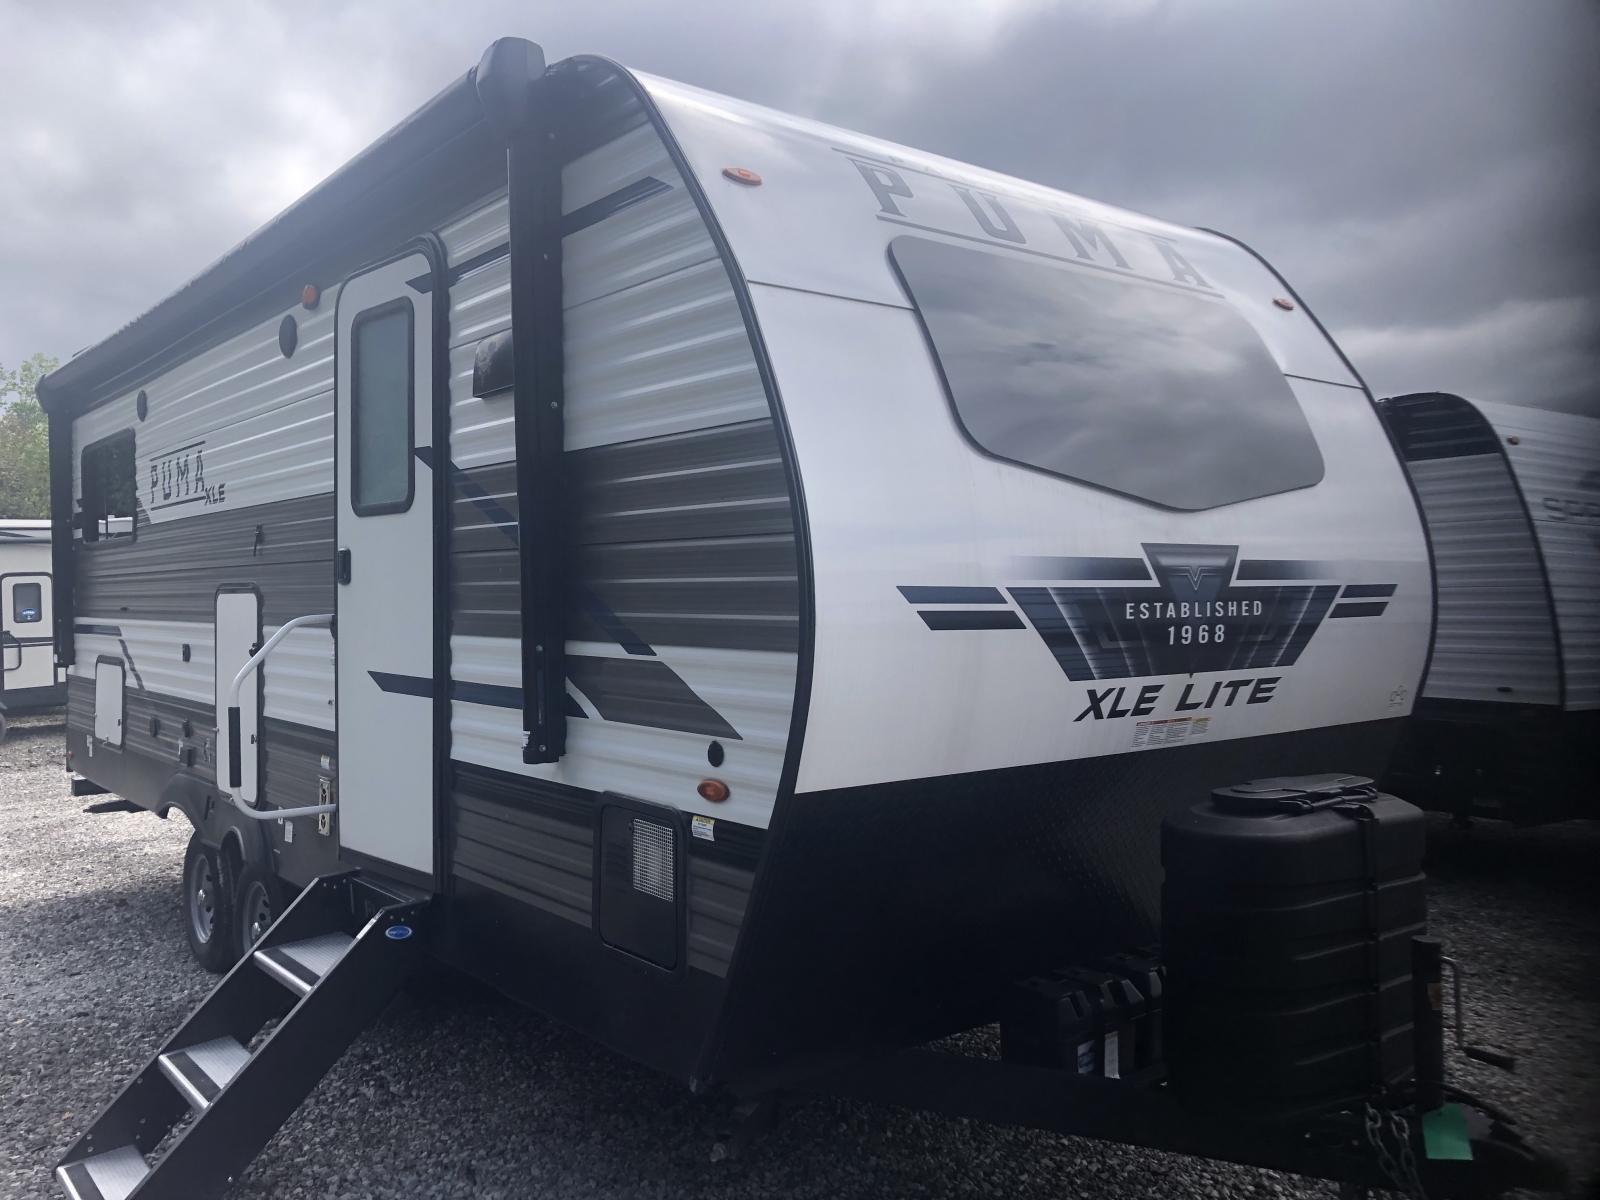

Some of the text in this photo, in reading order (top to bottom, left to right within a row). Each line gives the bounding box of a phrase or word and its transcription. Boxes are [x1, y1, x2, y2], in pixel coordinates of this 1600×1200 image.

[845, 156, 1216, 290] PUMA
[150, 449, 205, 504] PUMA
[204, 483, 226, 506] XLE
[1125, 600, 1263, 620] ESTABLISHED
[1167, 624, 1226, 645] 1968
[1073, 676, 1282, 722] XLE LITE
